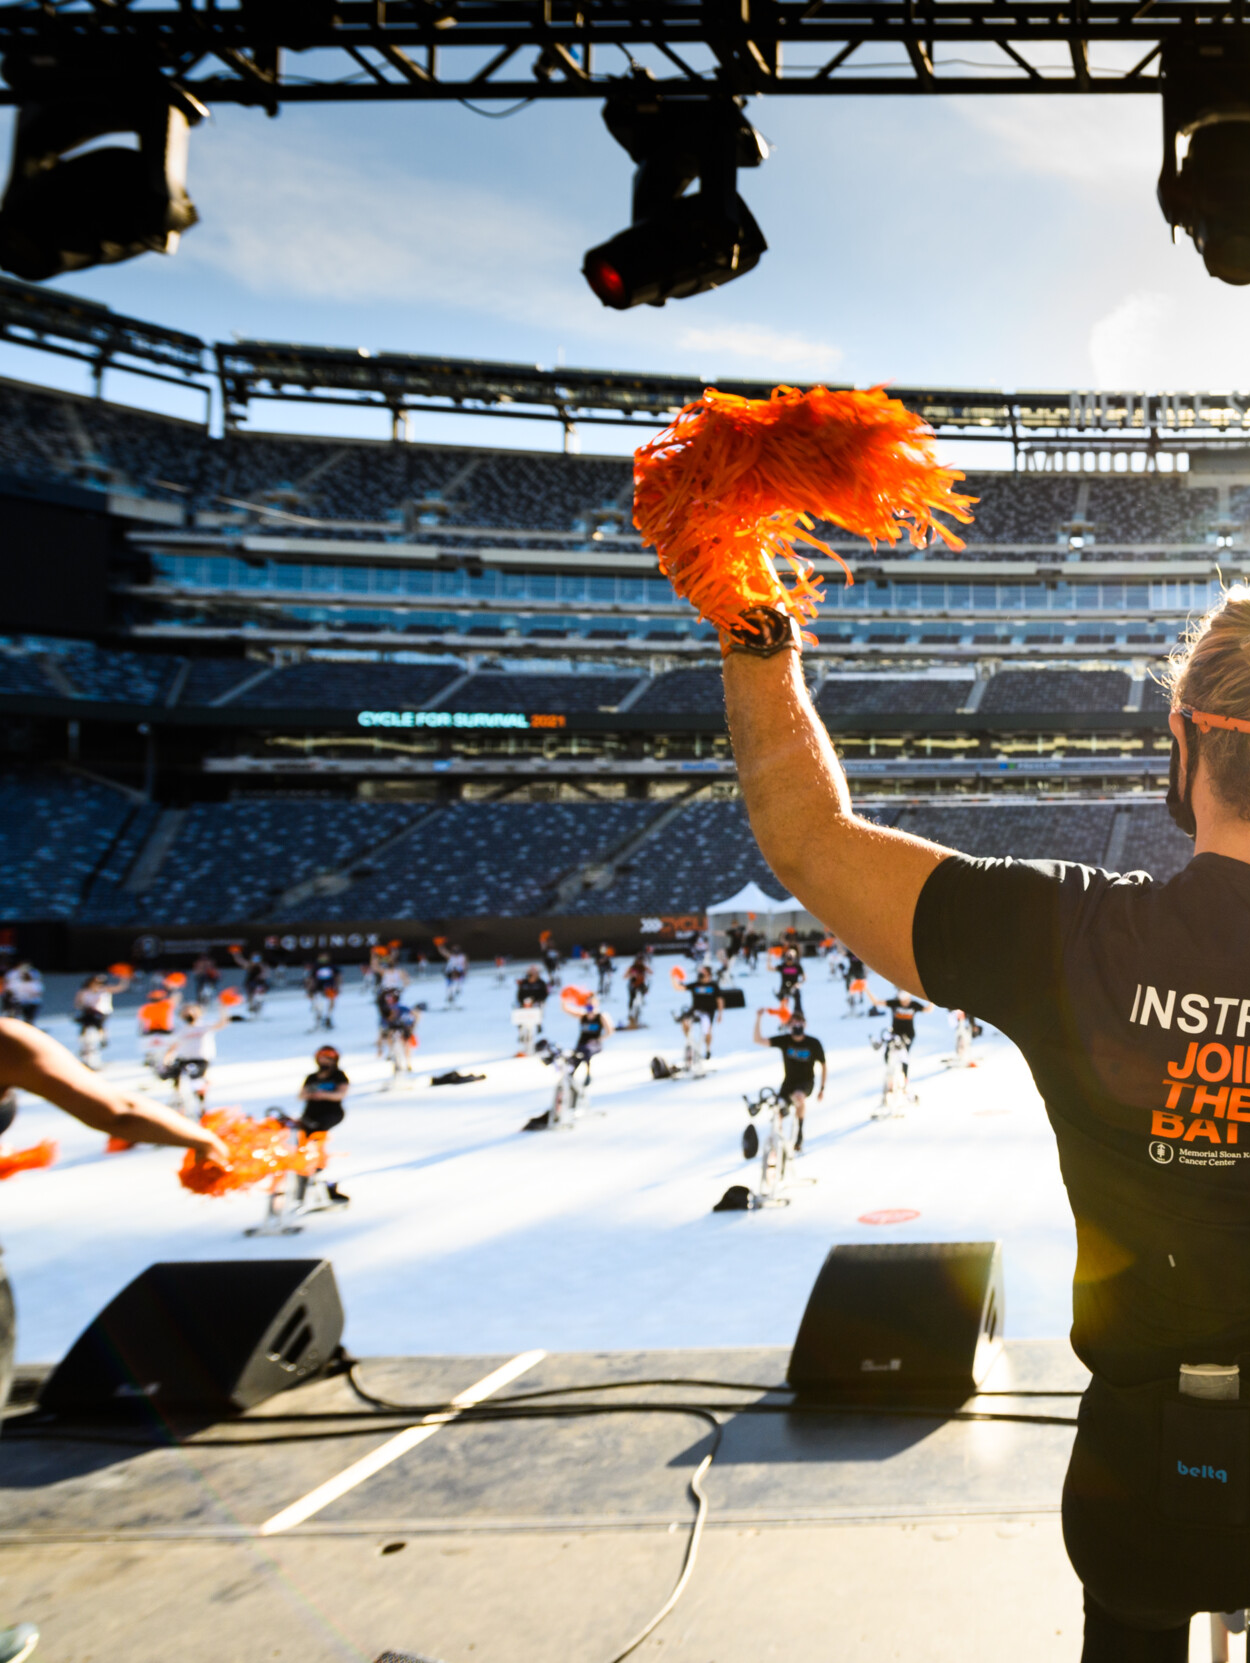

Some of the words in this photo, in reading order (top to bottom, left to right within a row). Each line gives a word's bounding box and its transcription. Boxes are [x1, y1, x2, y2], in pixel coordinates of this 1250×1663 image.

[357, 711, 414, 727] CYCLE
[416, 712, 451, 727] FOR
[453, 712, 529, 728] SURVIVAL
[264, 933, 380, 950] EQUINOX
[1178, 1148, 1218, 1158] Memorial
[1219, 1150, 1242, 1159] Sloan
[1178, 1156, 1207, 1166] Cancer
[1208, 1158, 1237, 1166] Center
[1177, 1460, 1228, 1483] beltq
